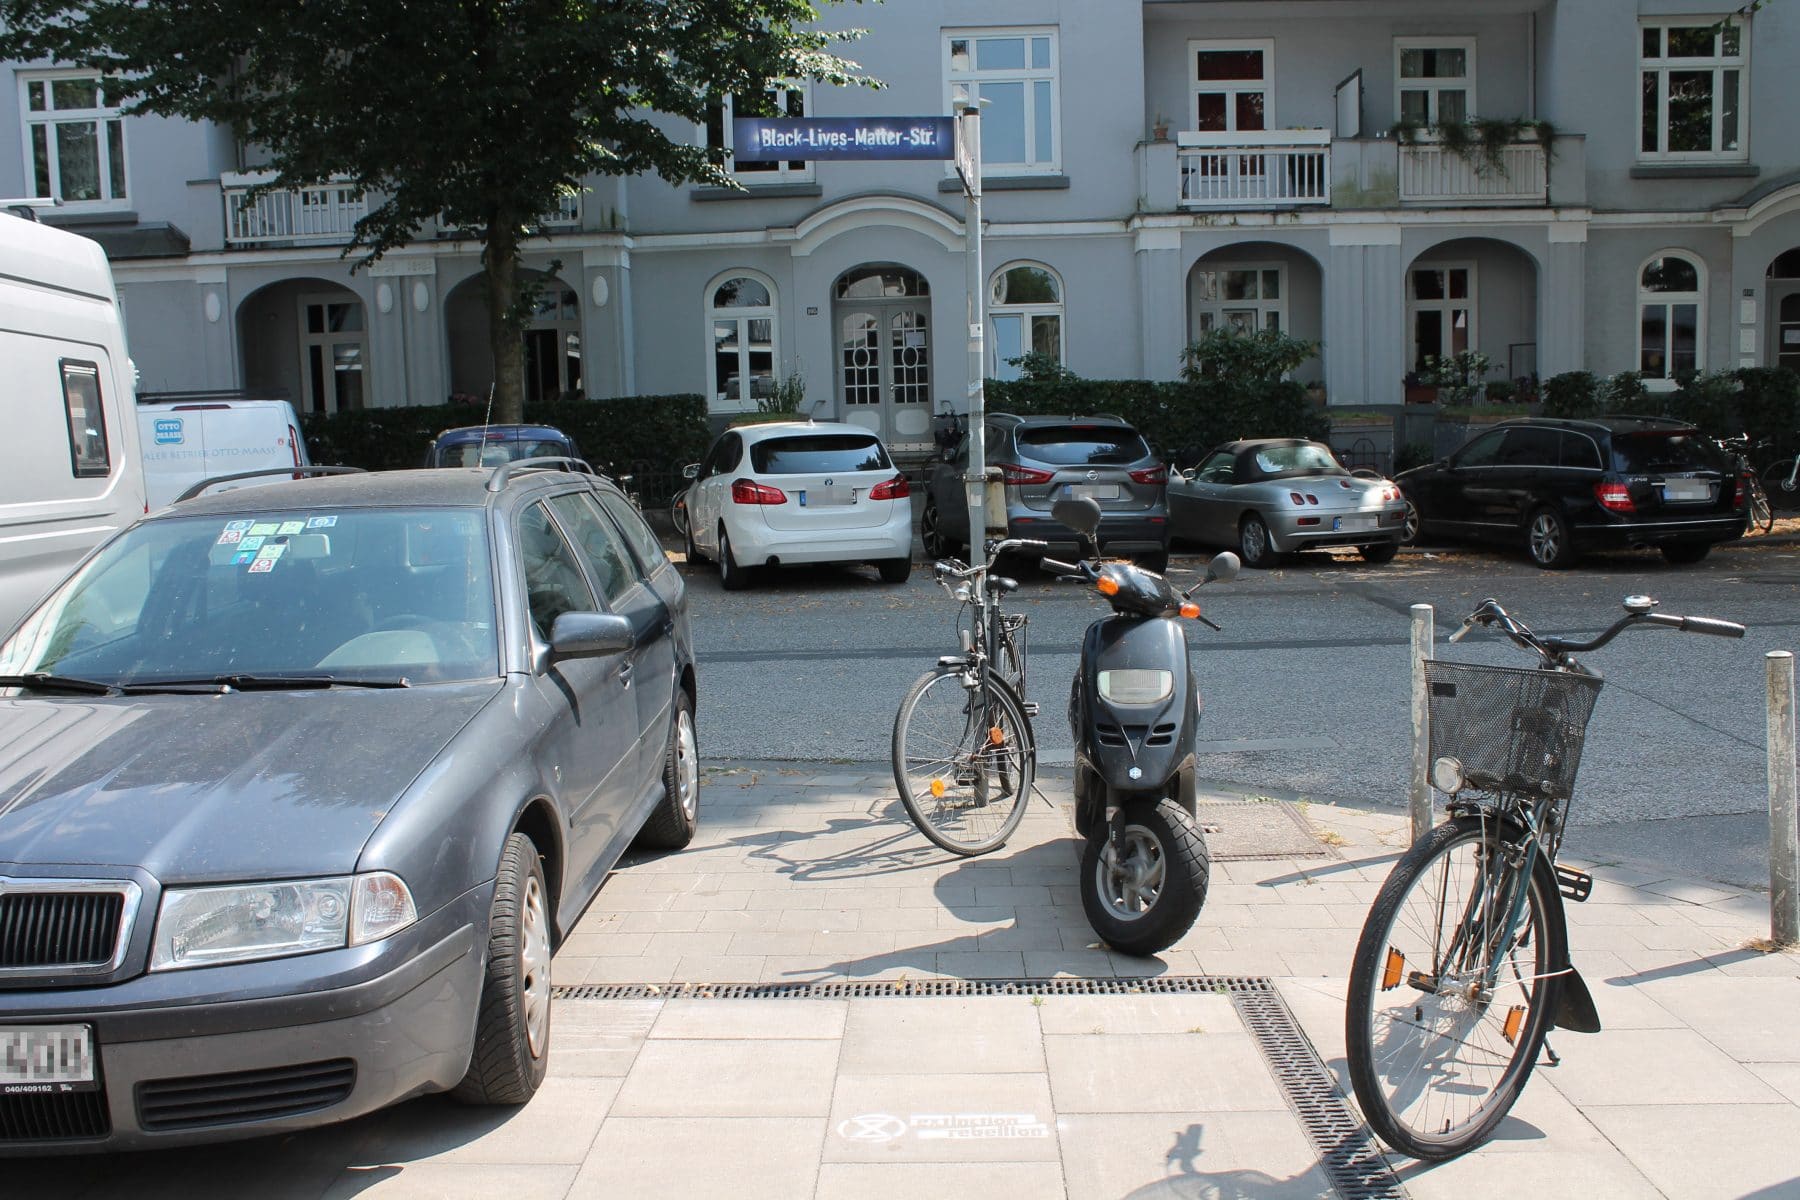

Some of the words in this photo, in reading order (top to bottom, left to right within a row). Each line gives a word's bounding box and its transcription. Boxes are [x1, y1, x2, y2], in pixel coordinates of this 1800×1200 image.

[761, 127, 936, 147] Black-Lives-Matter-Str.
[157, 423, 181, 431] OTTO
[143, 451, 167, 461] ALER
[947, 1126, 1042, 1138] rebellion
